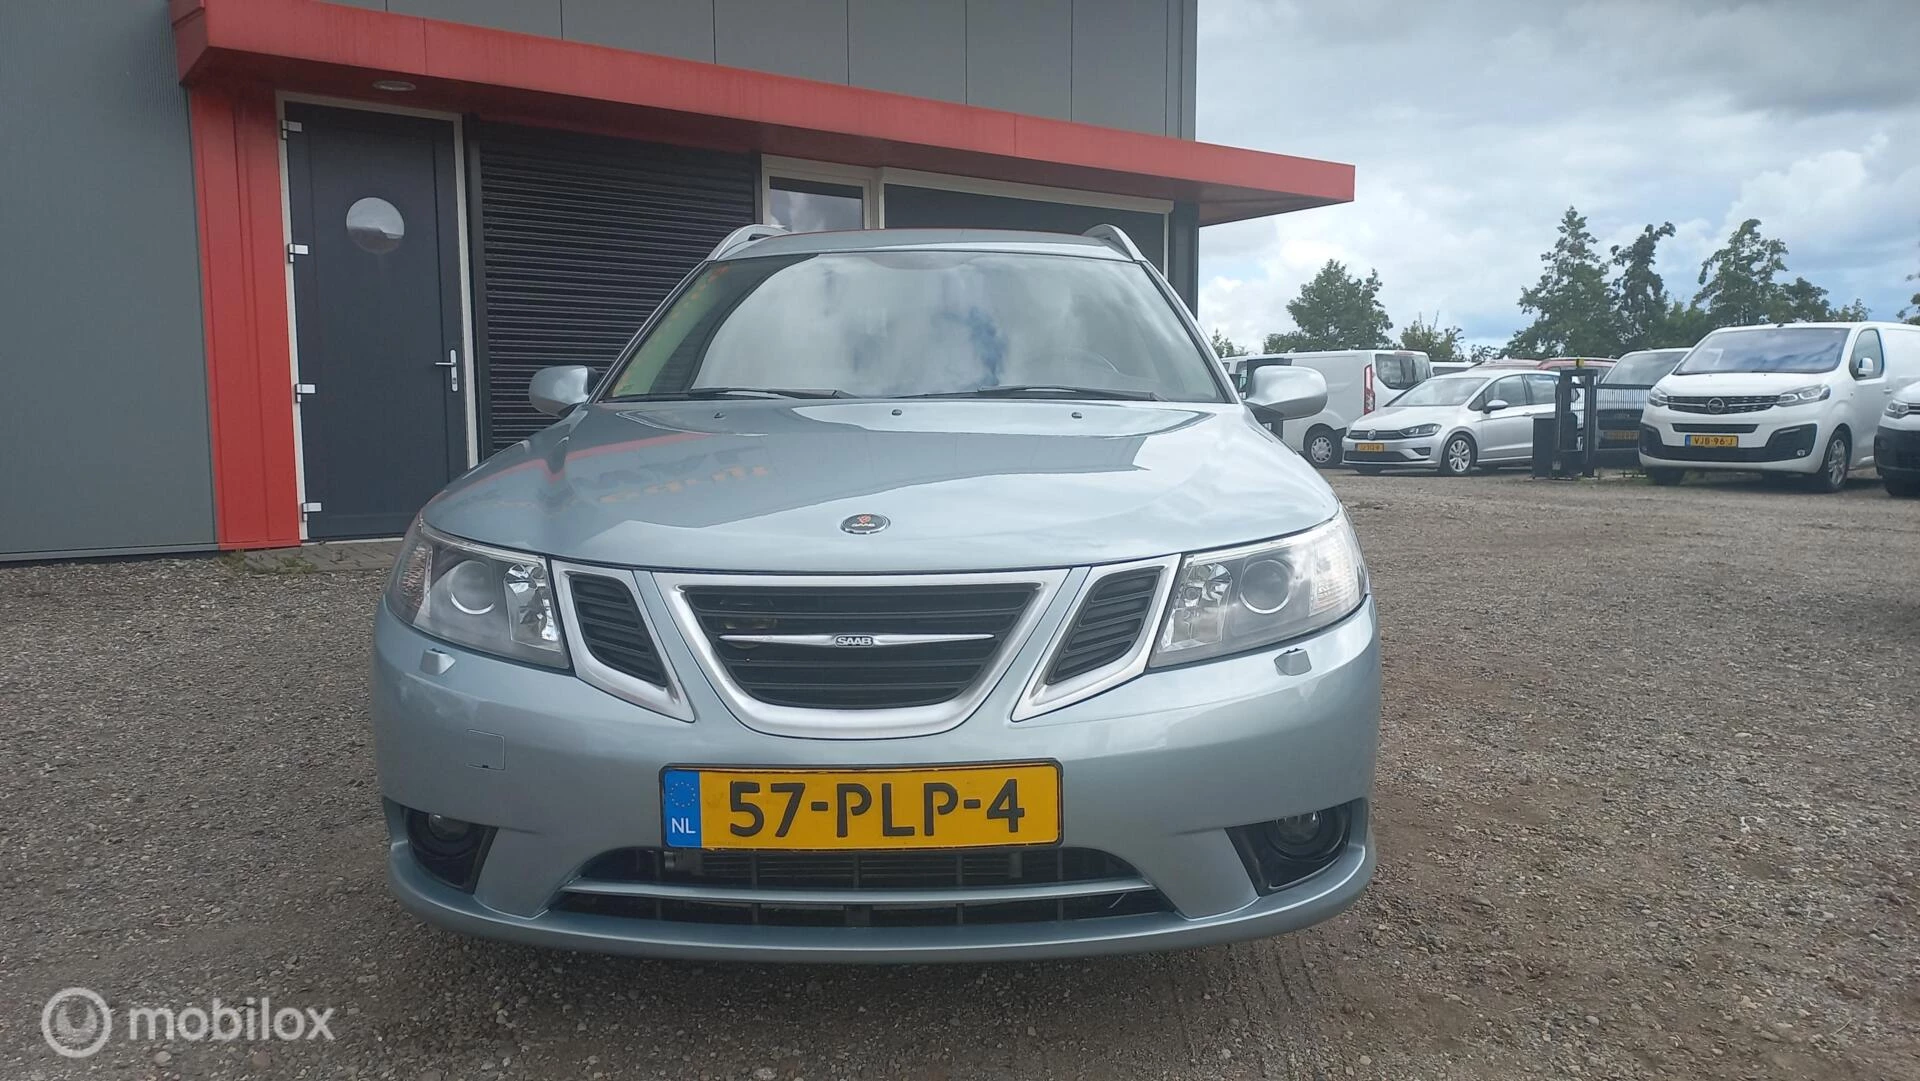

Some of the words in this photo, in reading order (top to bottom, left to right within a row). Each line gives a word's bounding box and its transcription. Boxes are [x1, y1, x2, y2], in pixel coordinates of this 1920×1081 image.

[837, 637, 873, 646] SAAB
[729, 779, 1025, 838] 57-PLP-4
[671, 817, 696, 834] NL
